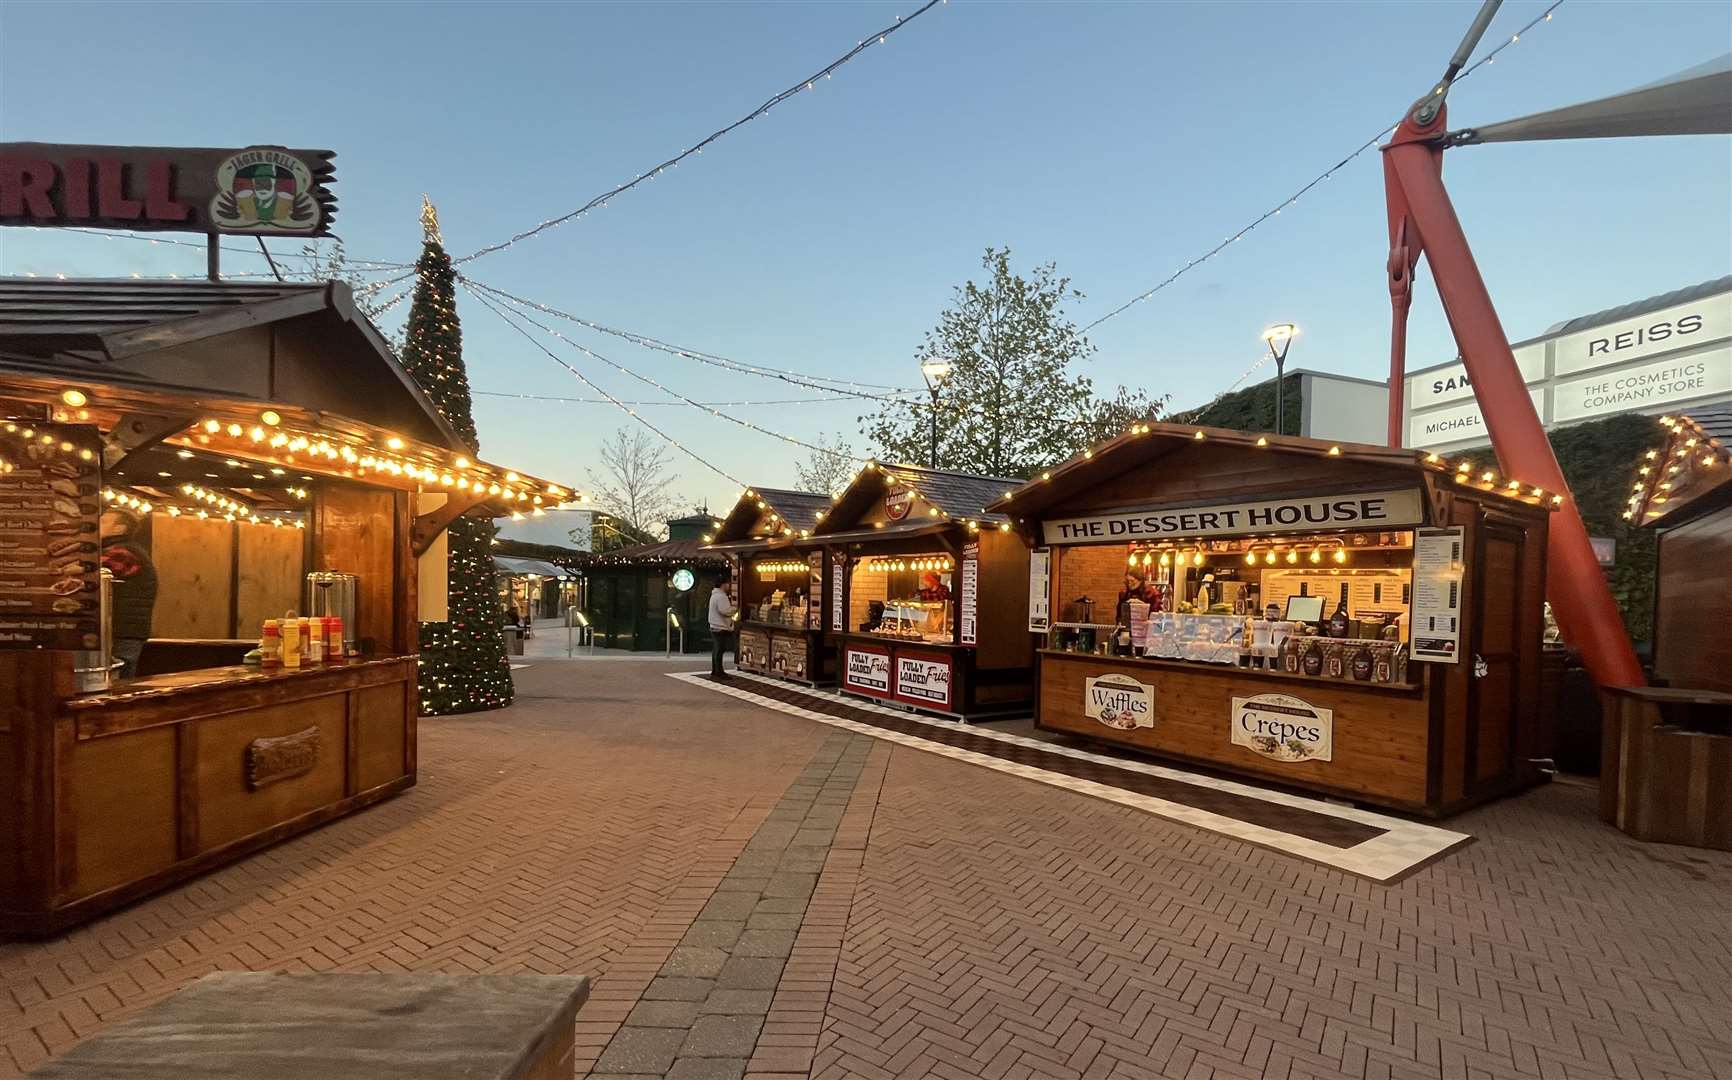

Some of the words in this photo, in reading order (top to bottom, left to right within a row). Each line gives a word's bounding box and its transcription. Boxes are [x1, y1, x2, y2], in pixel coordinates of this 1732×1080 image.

[265, 151, 296, 169] GRILL
[0, 155, 190, 221] RILL
[1589, 315, 1702, 357] REISS
[1585, 383, 1609, 396] THE
[1615, 363, 1705, 390] COSMETICS
[1583, 386, 1654, 409] COMPANY
[1658, 377, 1705, 395] STORE
[1426, 415, 1480, 434] MICHAEL
[1058, 523, 1104, 539] THE
[1110, 511, 1240, 535] DESSERT
[1248, 499, 1387, 526] HOUSE
[852, 653, 869, 664] FULLY
[903, 661, 923, 673] FULLY
[849, 663, 871, 675] LOADED
[900, 671, 926, 685] LOADED
[925, 666, 950, 685] Fries
[1092, 689, 1147, 713] Waffles
